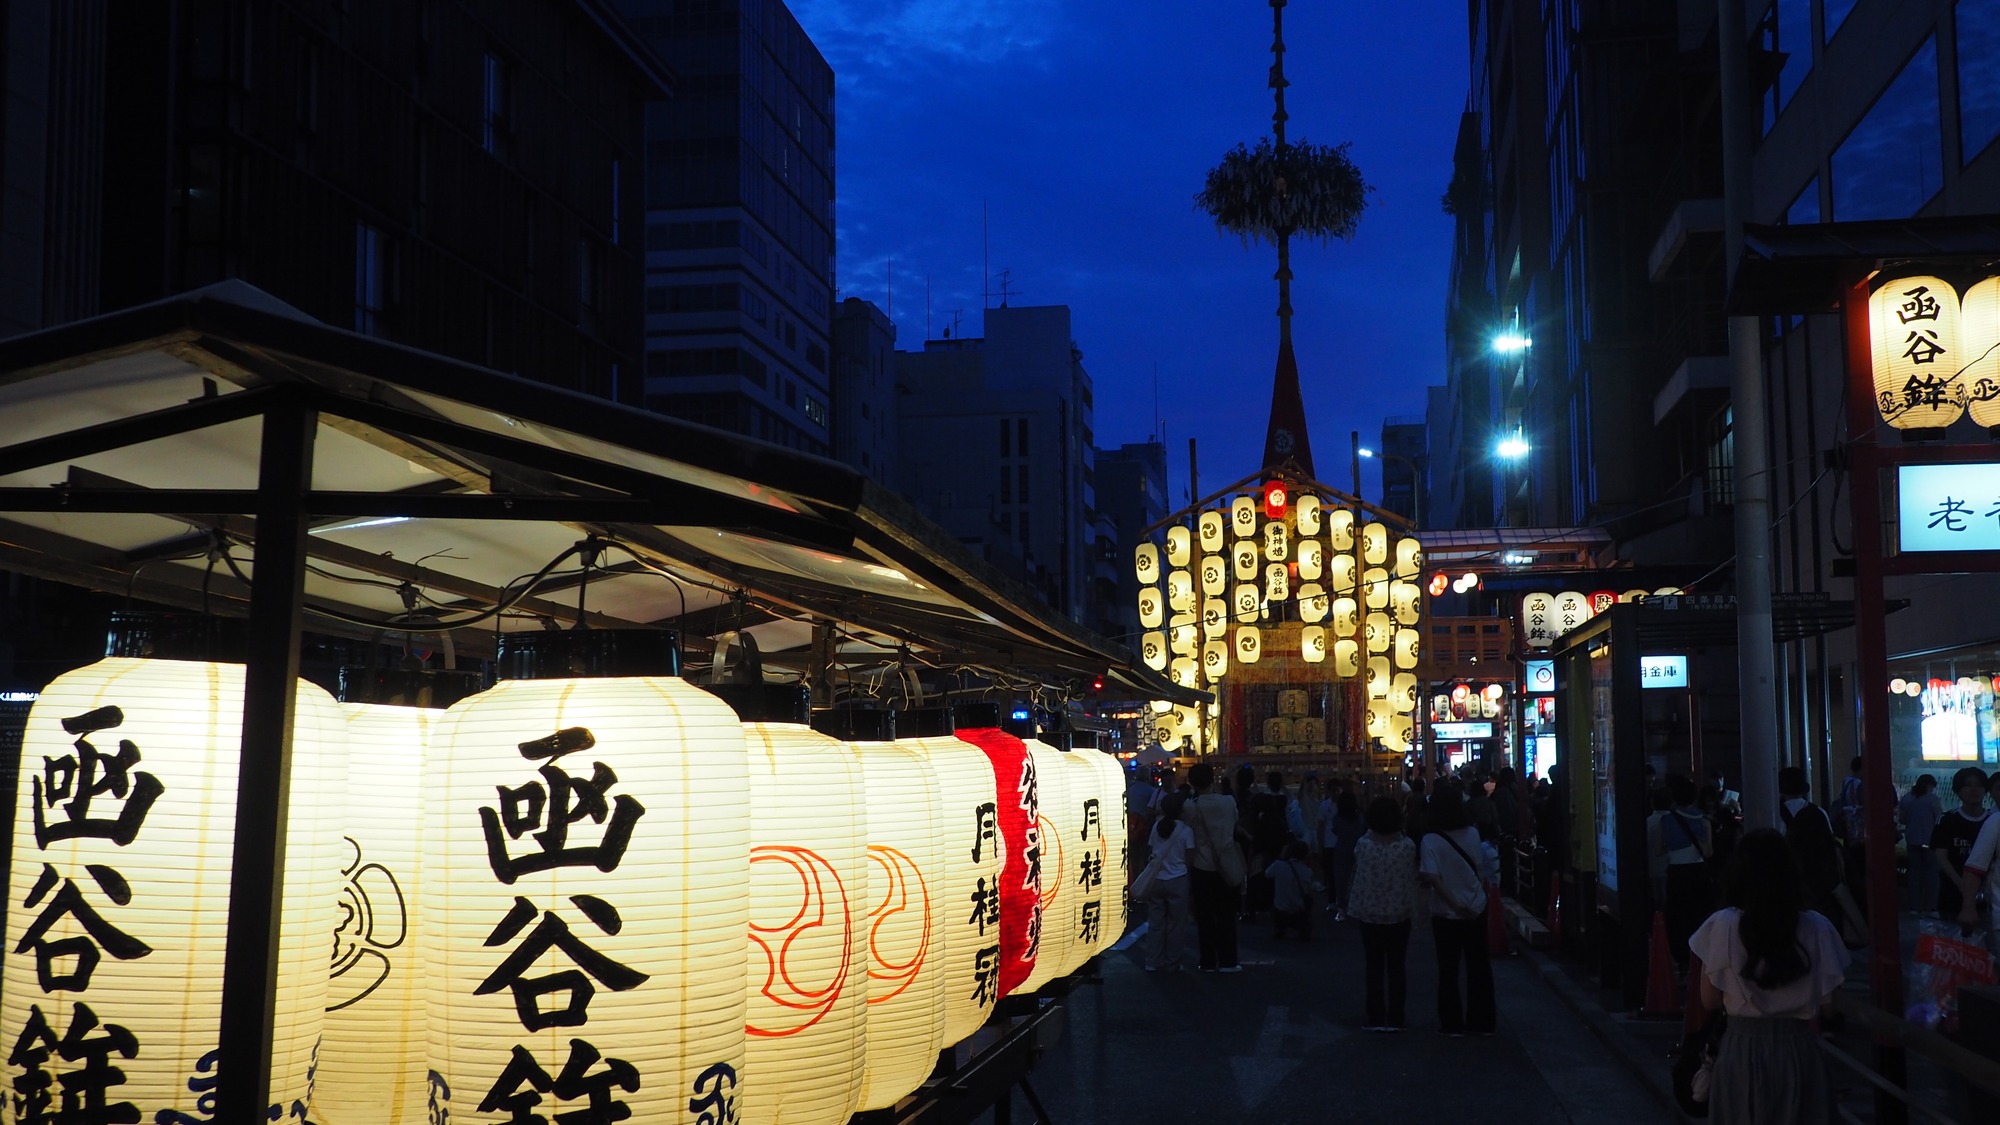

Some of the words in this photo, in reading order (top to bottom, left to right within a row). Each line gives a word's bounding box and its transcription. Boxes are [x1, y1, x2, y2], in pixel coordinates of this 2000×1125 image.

[1896, 286, 1949, 412] 函谷鉾
[1273, 567, 1284, 595] 函谷鉾
[1530, 599, 1546, 640] 函谷鉾
[1, 706, 164, 1125] 函谷鉾
[969, 802, 999, 1008] 月桂冠
[1074, 799, 1102, 944] 月桂冠
